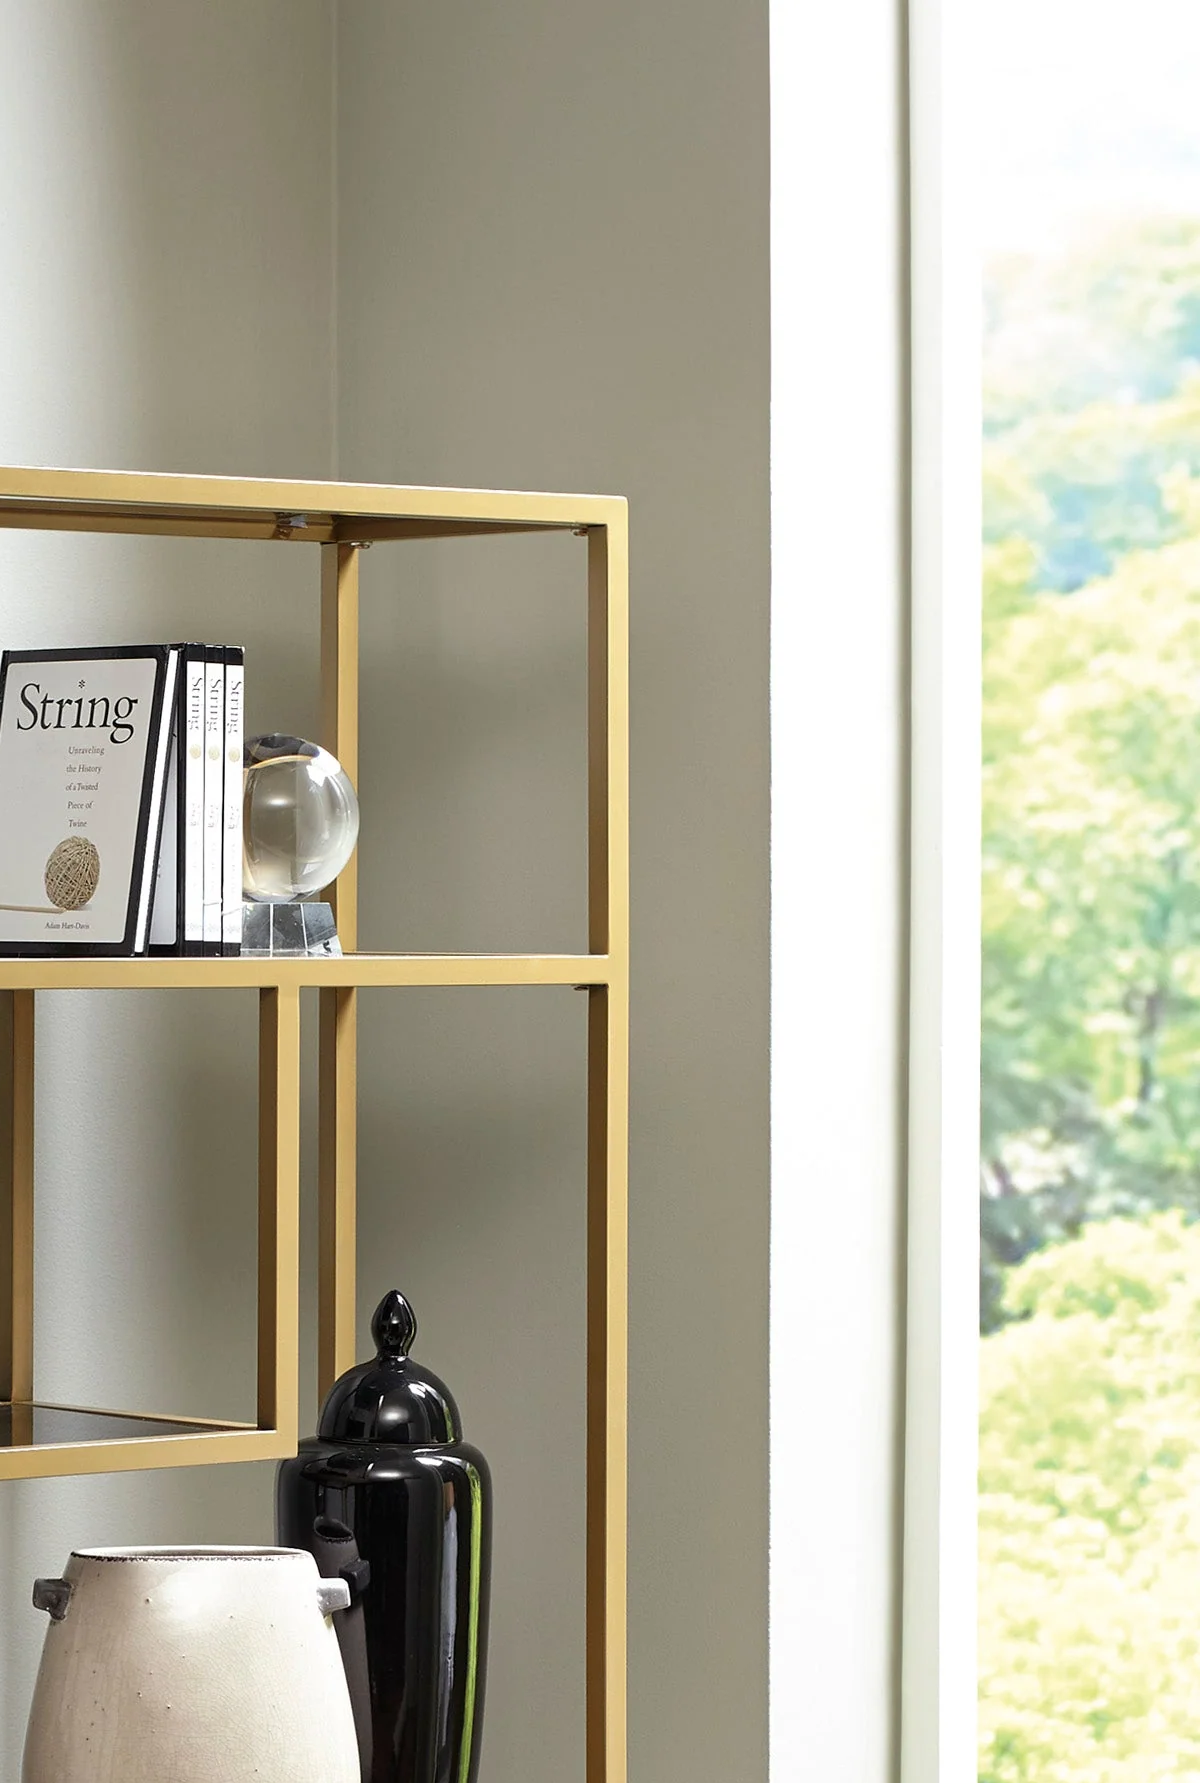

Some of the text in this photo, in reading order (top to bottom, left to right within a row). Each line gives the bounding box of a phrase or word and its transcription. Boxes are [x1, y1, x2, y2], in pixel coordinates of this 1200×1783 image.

[188, 677, 203, 730] String
[206, 679, 221, 732] String
[227, 681, 242, 734] String
[17, 680, 138, 744] String
[68, 746, 104, 756] Unraveling
[66, 764, 101, 774] the History
[65, 782, 73, 791] of
[77, 782, 99, 791] Twisted
[67, 801, 94, 809] Piece of
[68, 819, 87, 828] Twine
